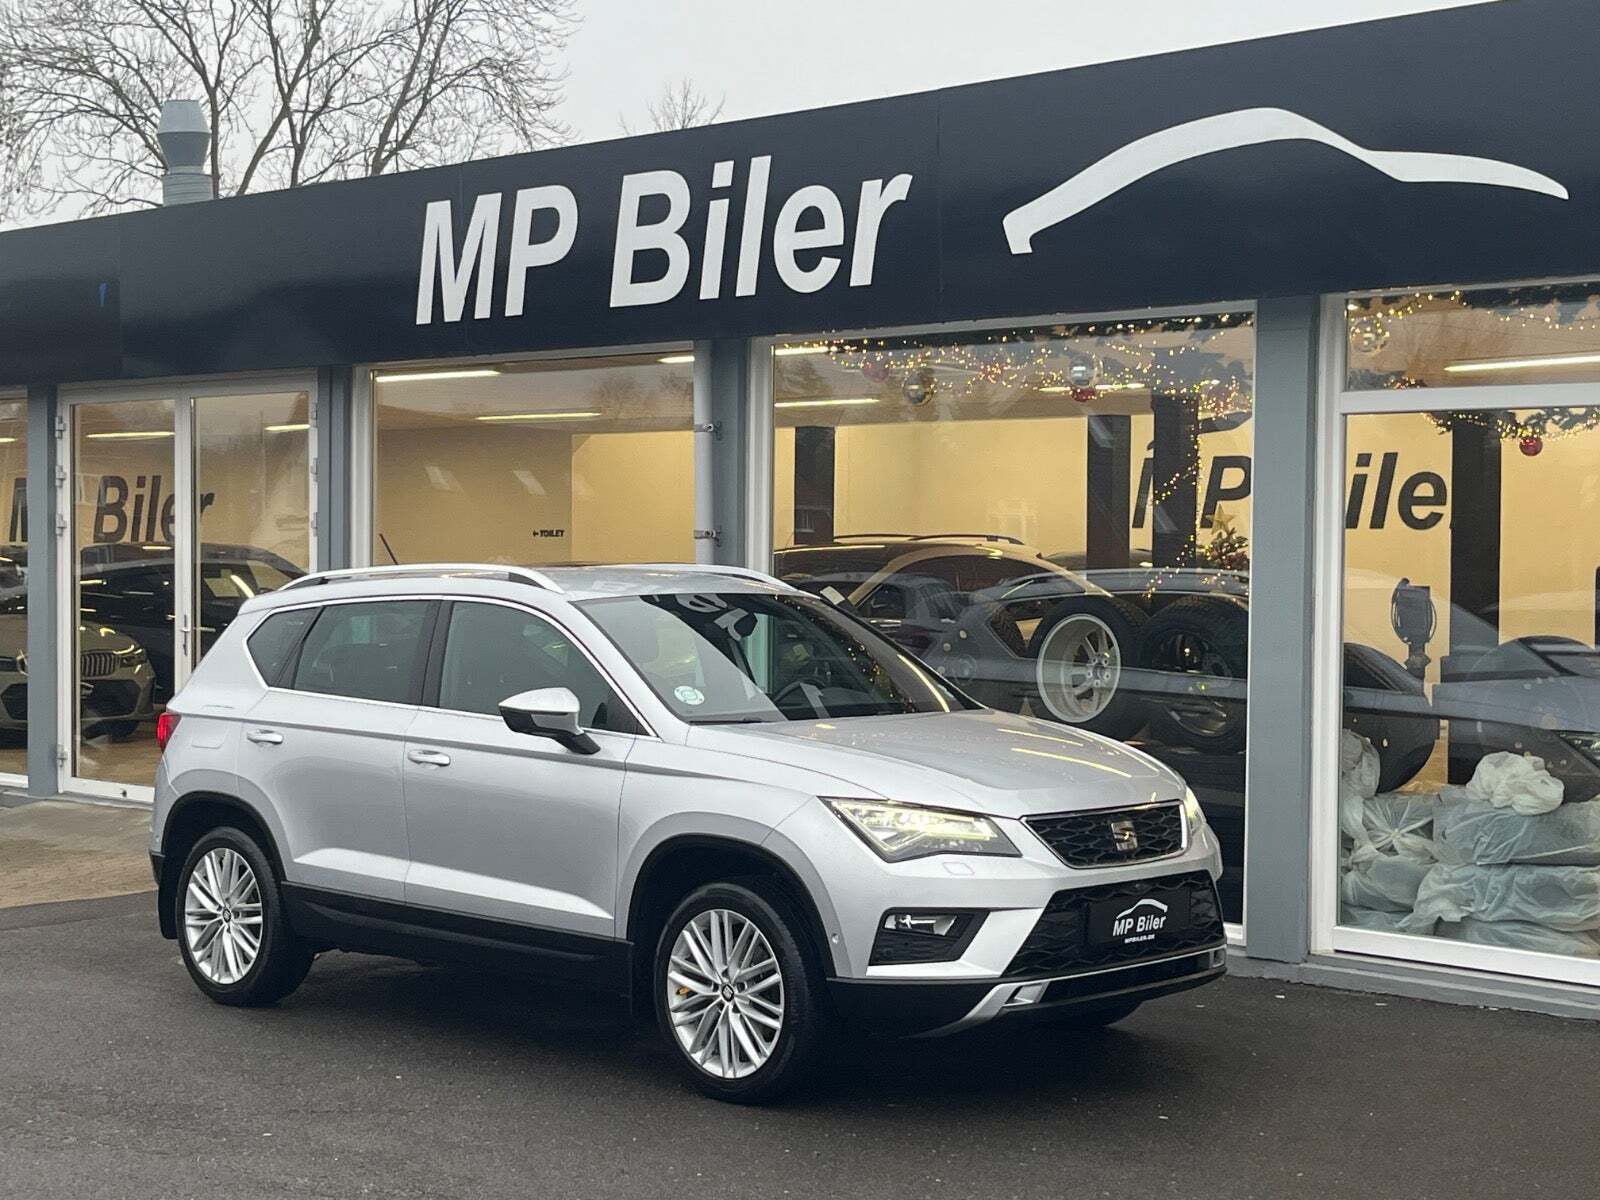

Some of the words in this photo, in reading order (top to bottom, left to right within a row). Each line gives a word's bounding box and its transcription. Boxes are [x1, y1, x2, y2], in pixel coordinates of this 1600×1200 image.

[415, 184, 578, 325] MP
[609, 155, 913, 307] Biler
[1132, 456, 1251, 529] P
[1345, 452, 1450, 530] ile
[540, 529, 564, 537] TOILET
[1113, 918, 1134, 936] MP
[1136, 914, 1166, 932] Biler
